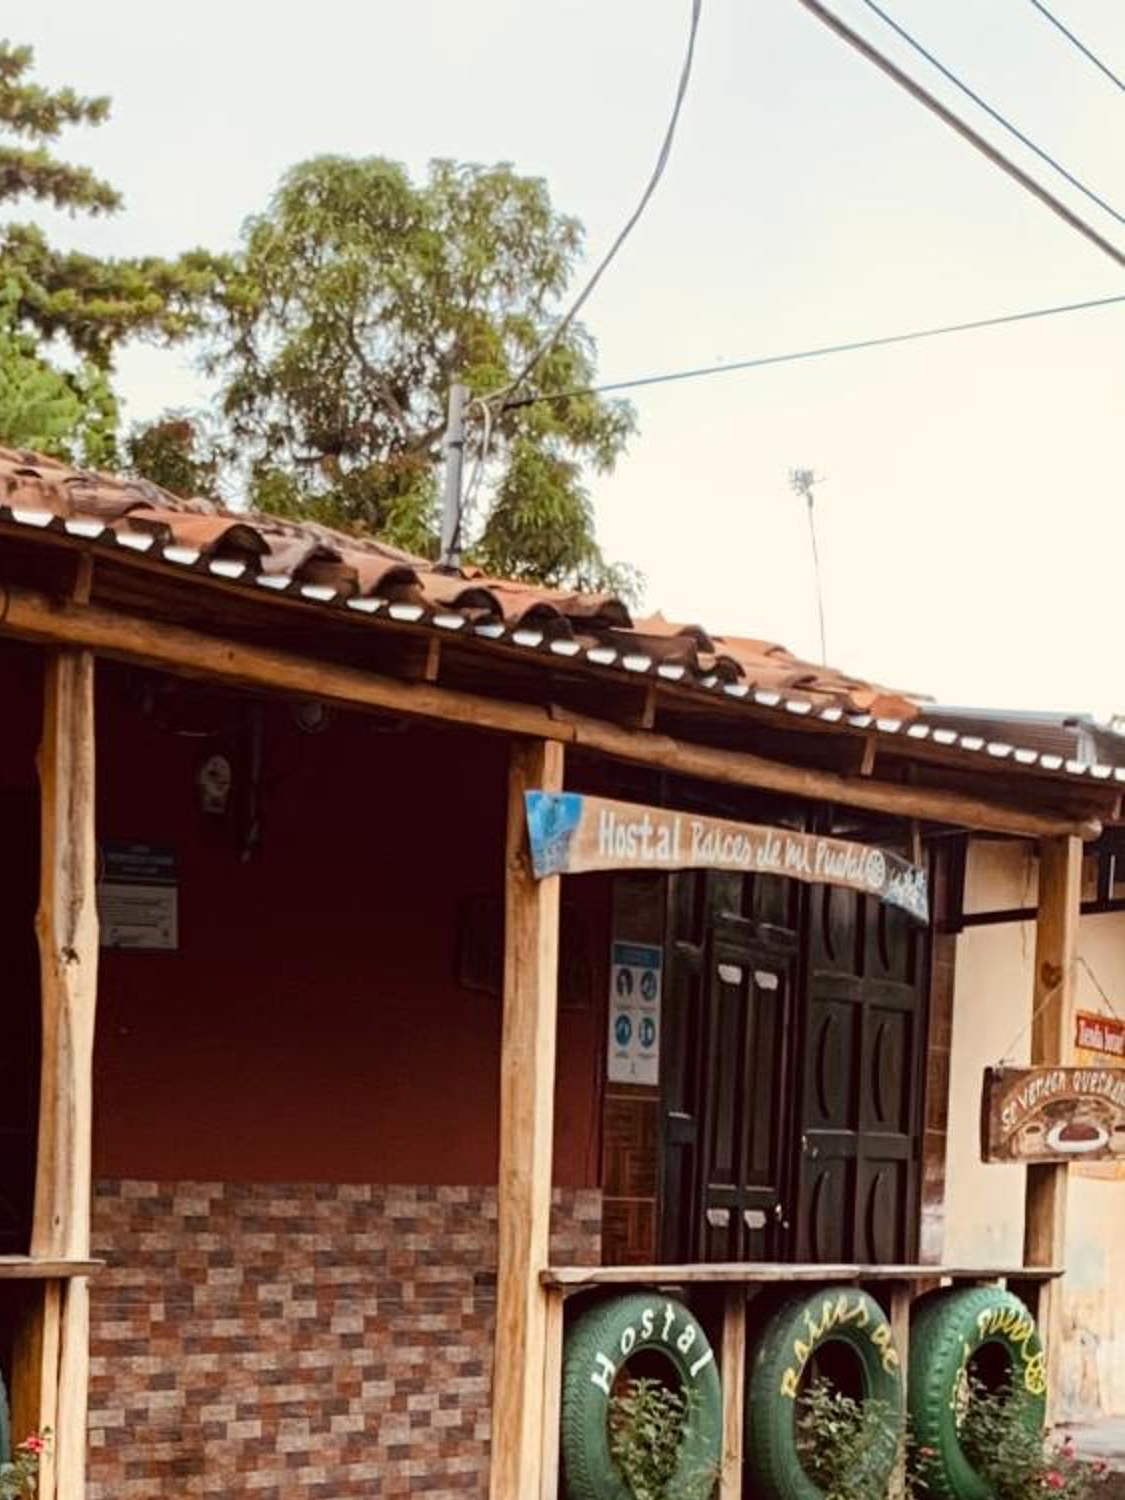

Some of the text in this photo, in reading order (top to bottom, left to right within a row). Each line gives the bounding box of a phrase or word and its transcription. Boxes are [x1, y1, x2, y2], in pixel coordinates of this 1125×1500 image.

[599, 809, 682, 861] Hostal
[755, 831, 782, 867] de
[591, 1303, 713, 1395] Hostal
